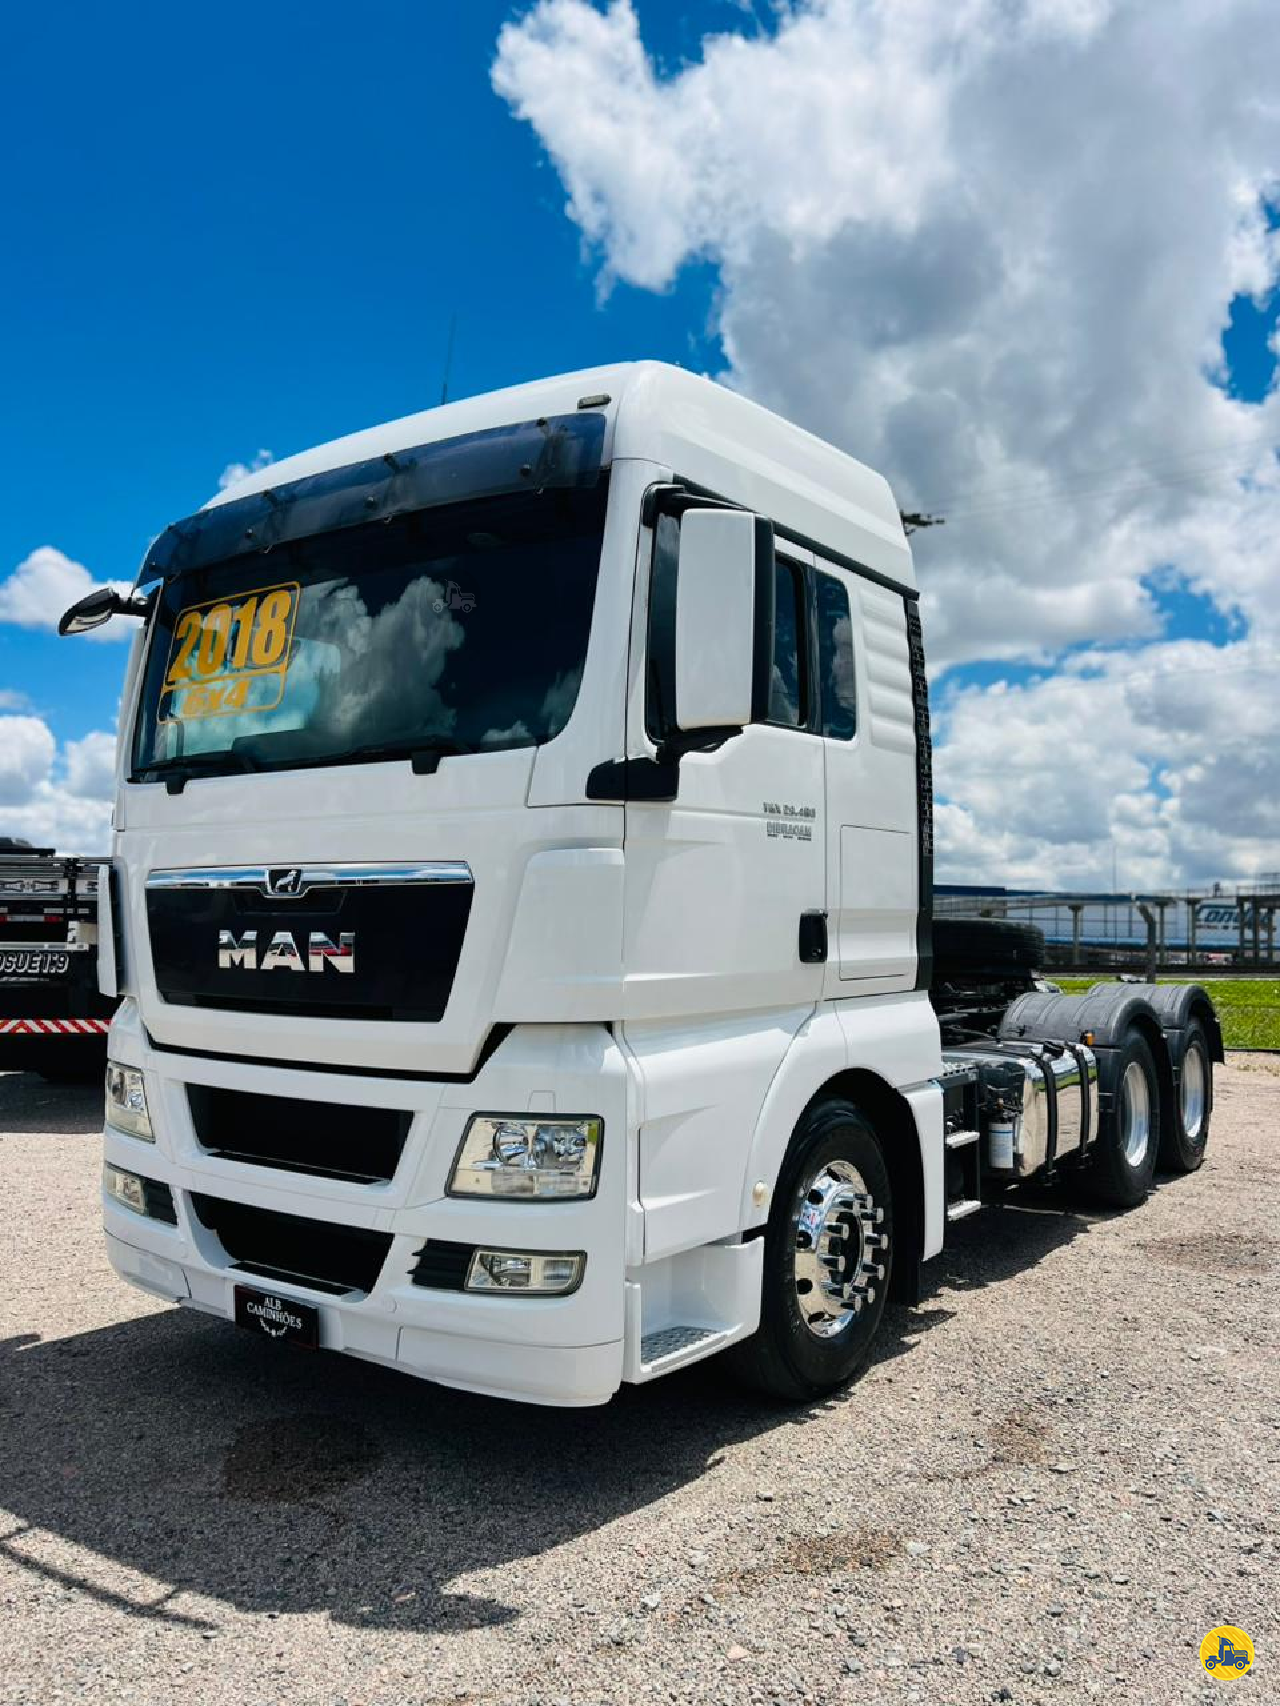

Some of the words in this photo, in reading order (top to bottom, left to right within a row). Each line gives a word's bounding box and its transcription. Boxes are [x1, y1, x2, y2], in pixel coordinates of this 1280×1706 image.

[168, 591, 292, 682] 2018
[218, 929, 356, 973] MAN
[263, 1297, 282, 1311] ALB
